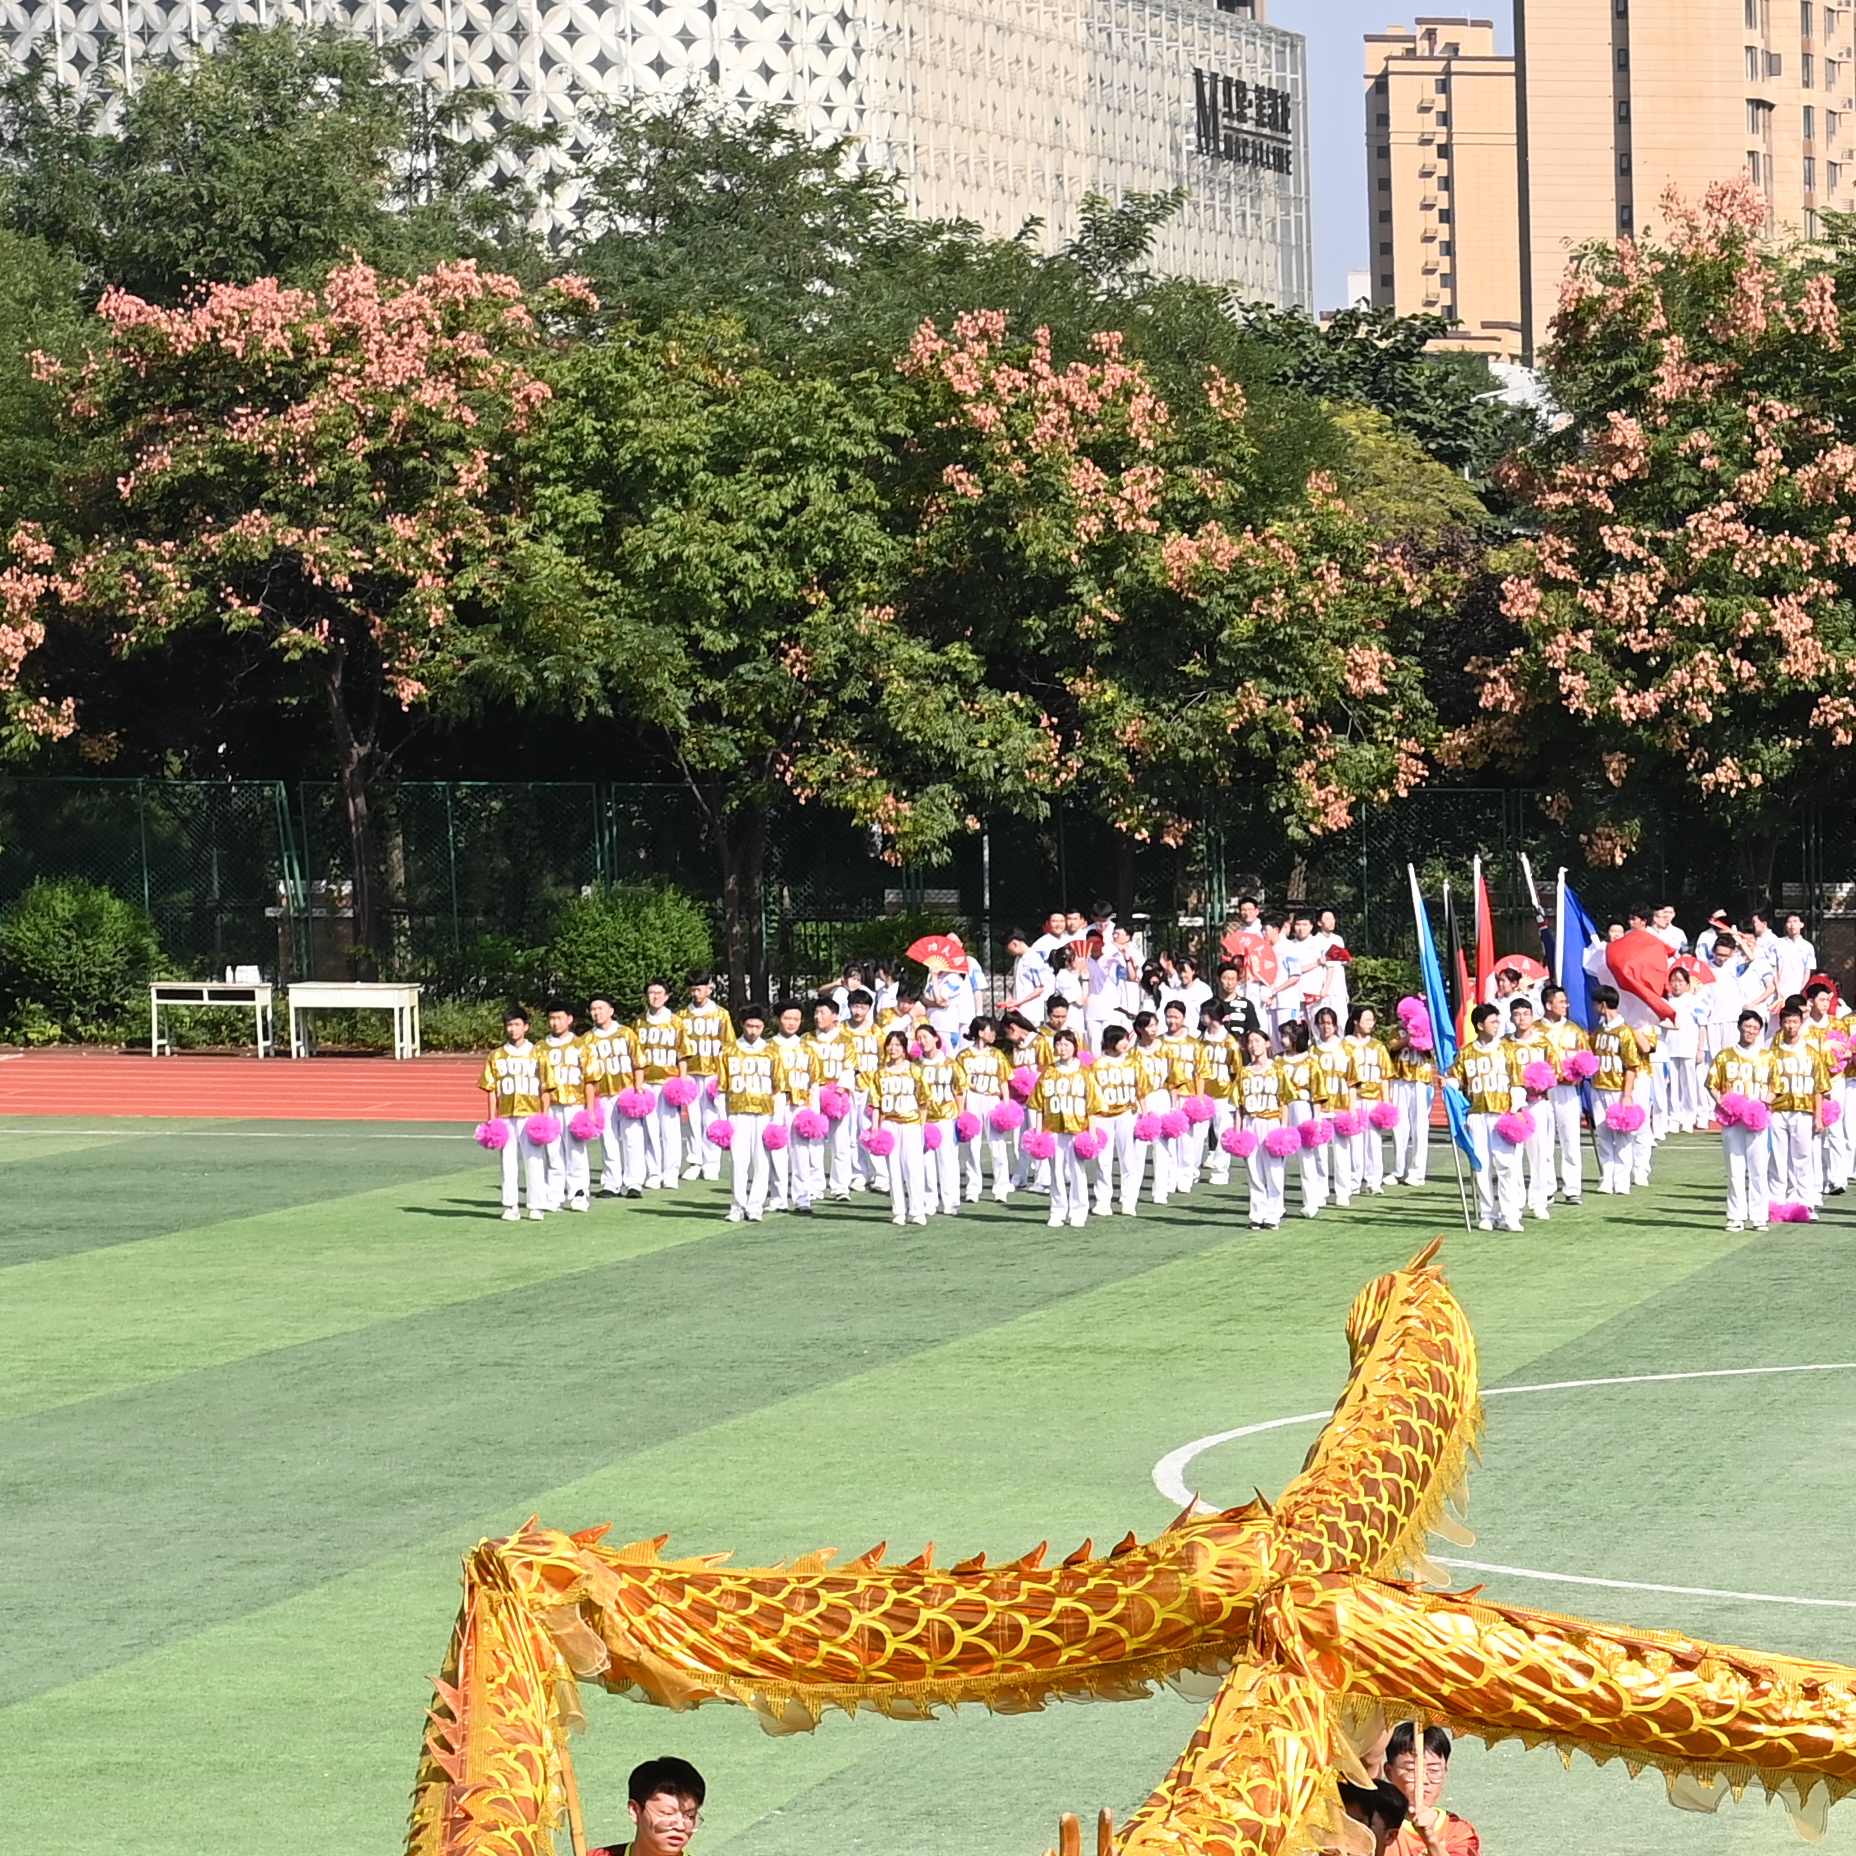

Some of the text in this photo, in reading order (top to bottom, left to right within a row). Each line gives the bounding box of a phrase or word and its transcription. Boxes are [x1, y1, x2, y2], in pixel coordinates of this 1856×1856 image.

[550, 1049, 581, 1066] ON
[1516, 1048, 1546, 1064] ON
[496, 1058, 539, 1077] BON
[728, 1057, 772, 1076] BON
[1465, 1056, 1506, 1078] BON
[1726, 1061, 1769, 1082] BON
[731, 1075, 773, 1094] OUR
[1044, 1077, 1086, 1096] BON
[1101, 1068, 1135, 1087] BON
[1242, 1077, 1278, 1095] BON
[1050, 1096, 1086, 1116] OUR
